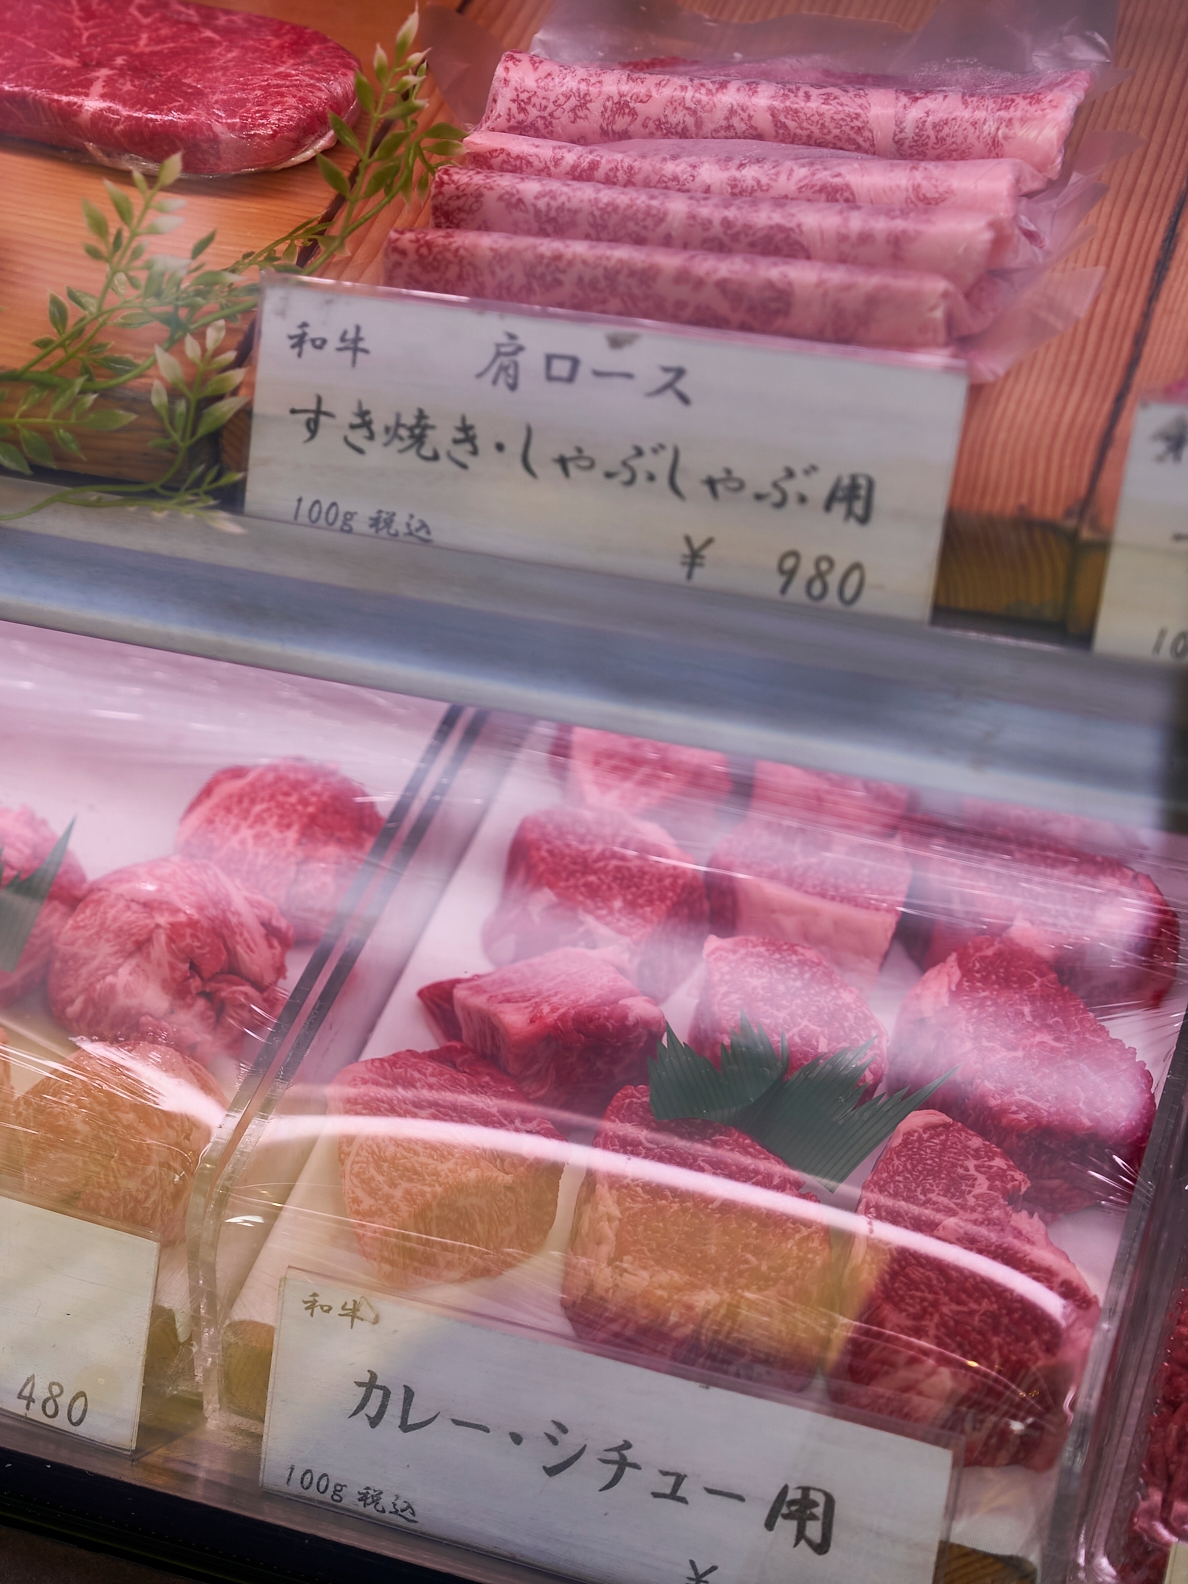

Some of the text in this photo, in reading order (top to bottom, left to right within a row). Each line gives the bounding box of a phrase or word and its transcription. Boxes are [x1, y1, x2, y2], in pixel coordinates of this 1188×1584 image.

[288, 322, 692, 405] 和牛 肩ロース
[292, 496, 434, 543] 100g 税込
[680, 534, 866, 607] ¥ 980
[301, 1292, 368, 1329] 和牛
[17, 1373, 89, 1427] 480
[348, 1369, 836, 1556] カレー・シチュー用
[286, 1464, 418, 1523] 100g 税込
